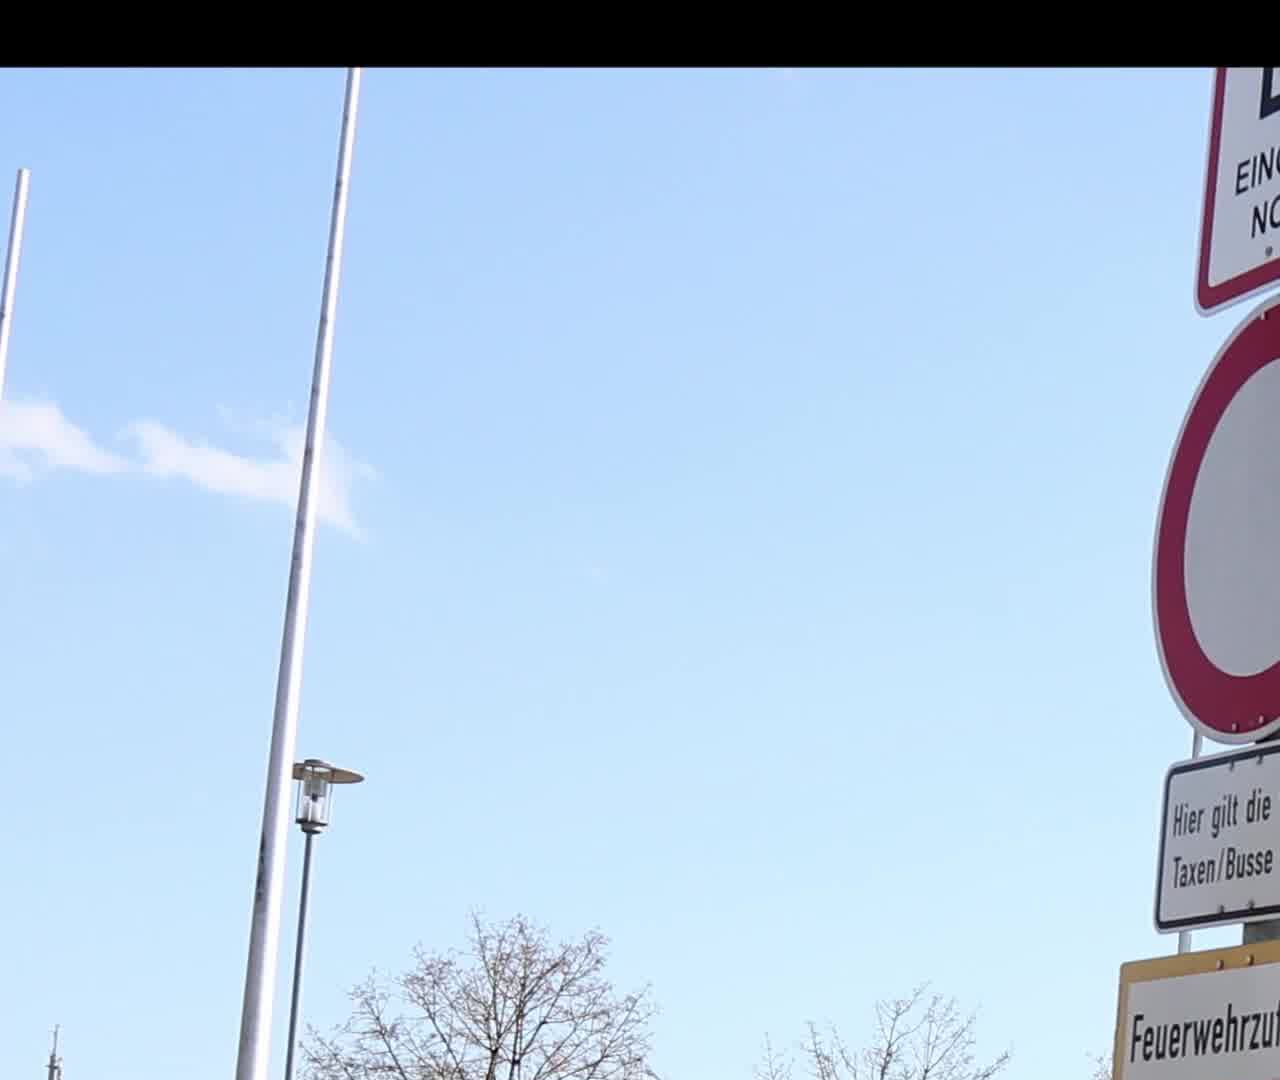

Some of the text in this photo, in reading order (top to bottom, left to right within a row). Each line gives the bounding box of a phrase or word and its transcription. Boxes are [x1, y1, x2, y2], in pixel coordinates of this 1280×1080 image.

[1173, 803, 1204, 837] Hier
[1211, 794, 1239, 839] gilt
[1246, 788, 1271, 825] die
[1173, 847, 1273, 889] Taxen/Busse
